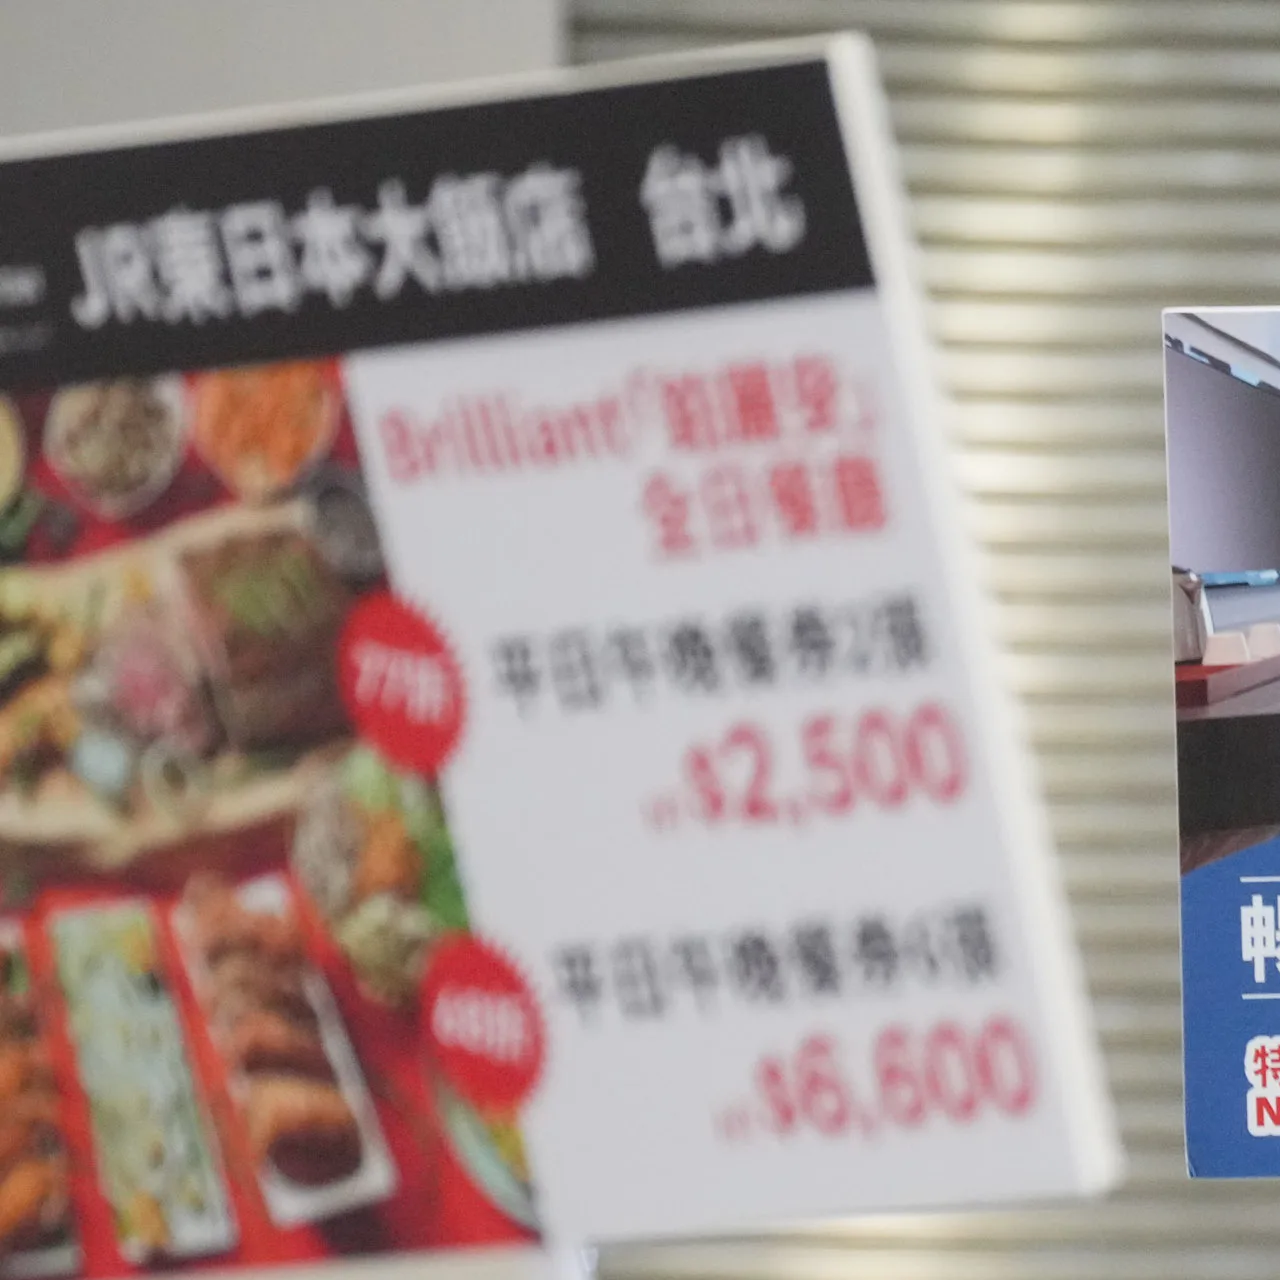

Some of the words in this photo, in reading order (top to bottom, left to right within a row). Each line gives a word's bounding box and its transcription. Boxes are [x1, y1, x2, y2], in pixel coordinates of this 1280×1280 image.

[72, 165, 592, 328] JR東日本大飯店
[640, 136, 802, 269] 台北
